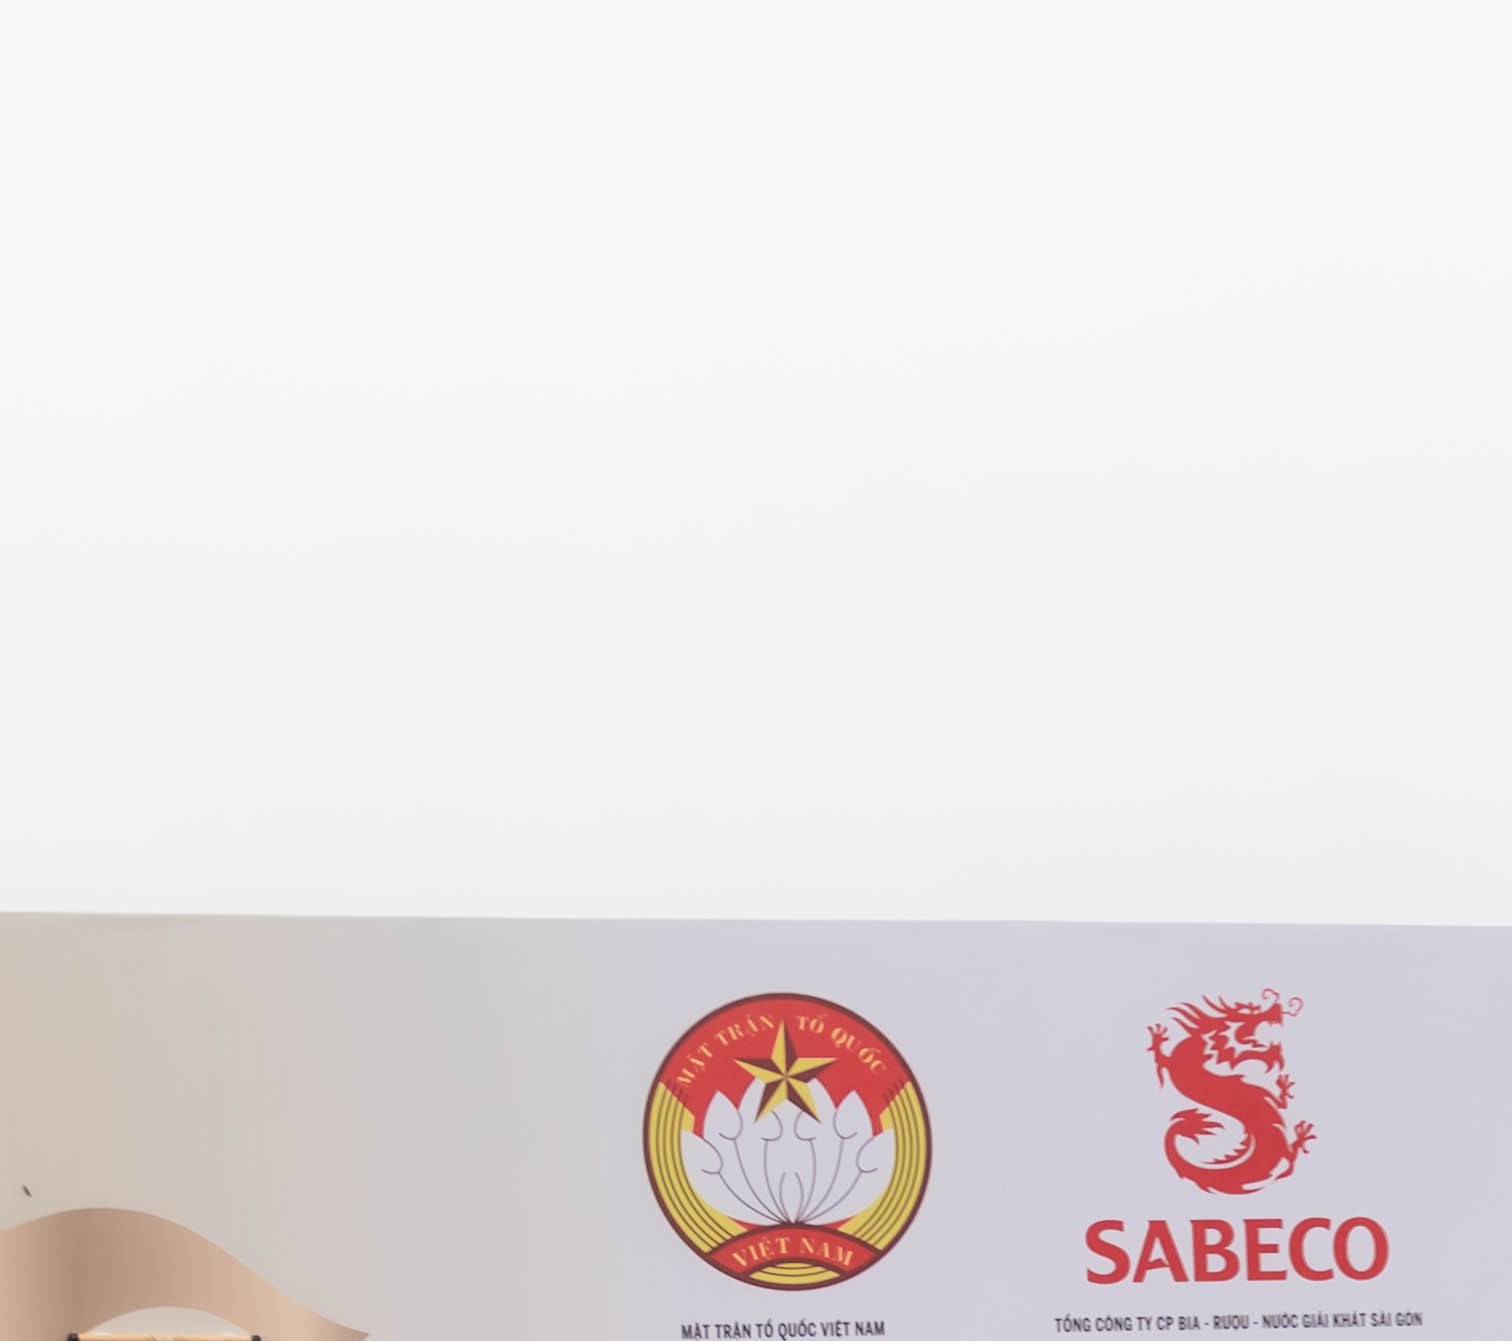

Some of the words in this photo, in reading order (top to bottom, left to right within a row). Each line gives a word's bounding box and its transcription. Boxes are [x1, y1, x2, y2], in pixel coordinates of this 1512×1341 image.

[732, 1237, 790, 1267] VIỆT
[801, 1238, 853, 1266] NAM
[1085, 1216, 1389, 1285] SABECO
[854, 1320, 886, 1336] NAM
[1137, 1316, 1152, 1330] TY
[1156, 1317, 1173, 1330] CP
[1178, 1316, 1200, 1330] BIA
